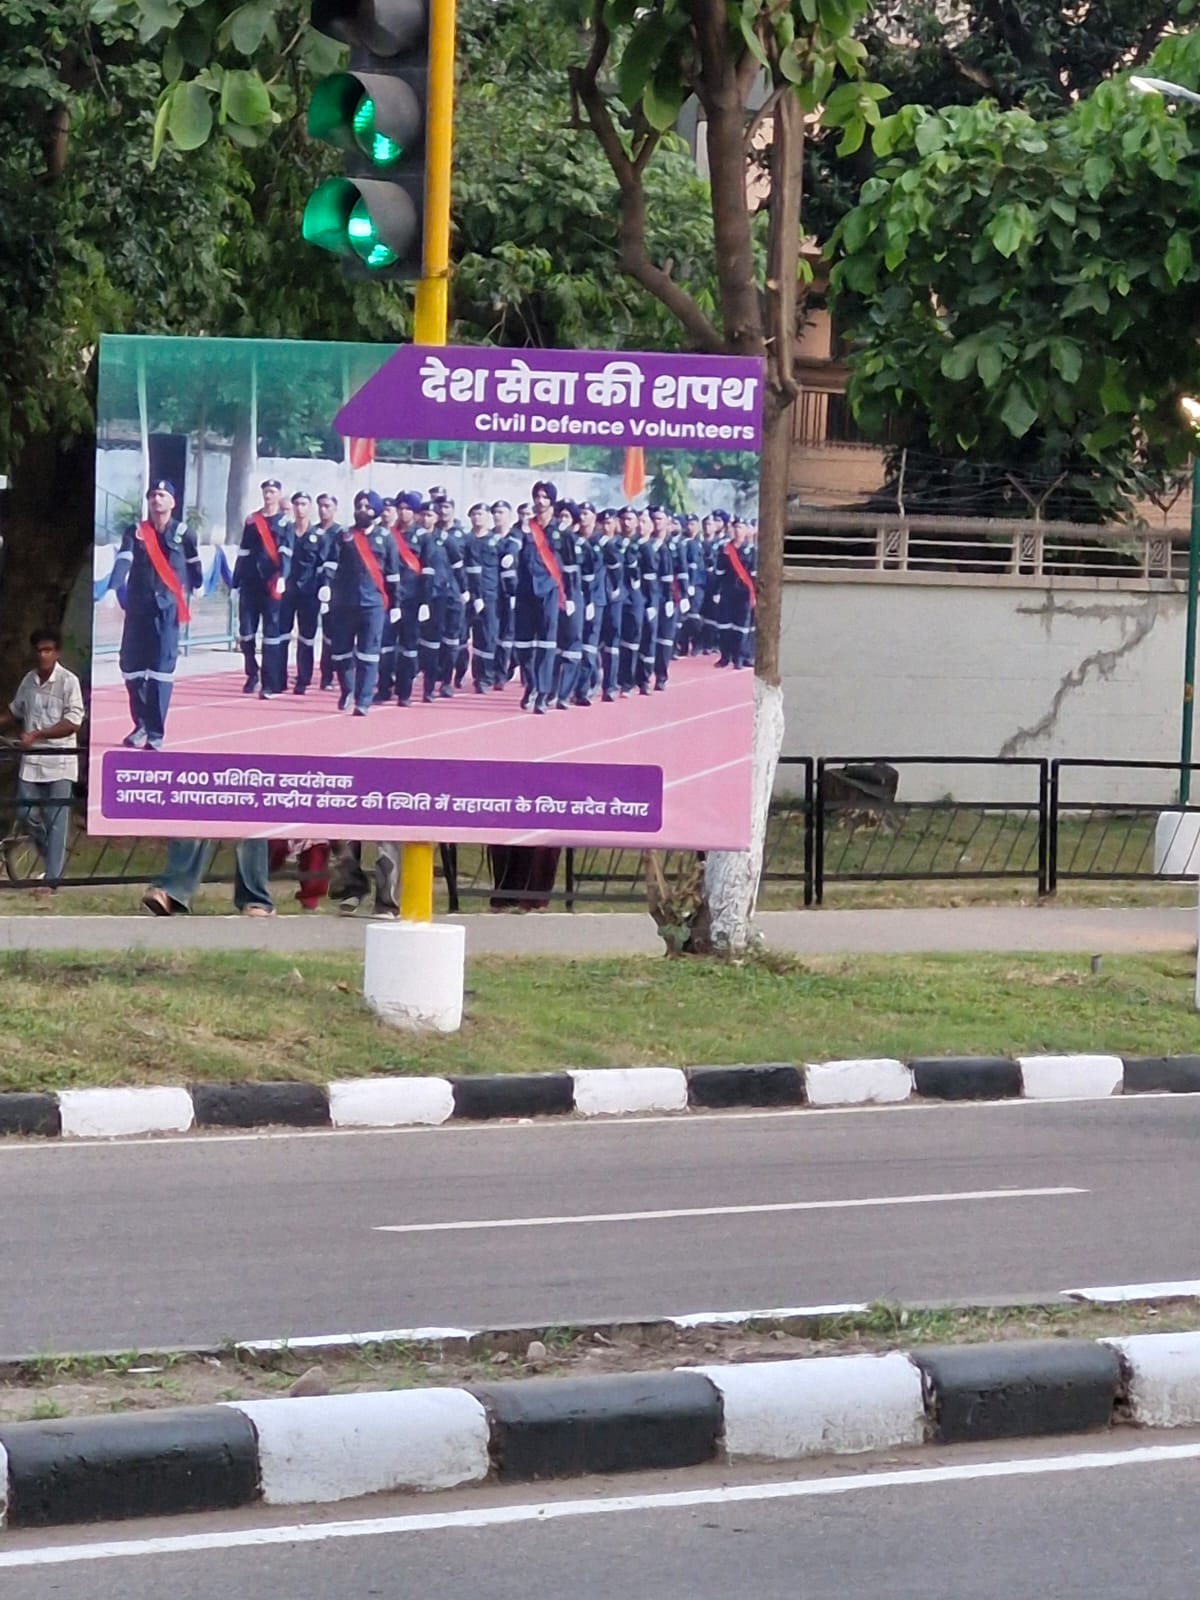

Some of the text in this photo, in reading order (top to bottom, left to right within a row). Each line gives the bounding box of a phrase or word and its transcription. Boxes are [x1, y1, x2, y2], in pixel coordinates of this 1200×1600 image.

[420, 357, 758, 411] देश सेवा की शपथ
[475, 413, 754, 439] Civil Defence Volunteers
[116, 769, 353, 789] लगभग 400 प्रशिक्षित स्वयंसेवक
[116, 790, 165, 805] आपदा,
[171, 791, 258, 807] आपातकाल,
[262, 791, 313, 808] राष्ट्रीय
[360, 792, 383, 808] की
[386, 792, 432, 810] स्थिति
[434, 794, 450, 811] में
[452, 798, 512, 813] सहायता
[515, 796, 533, 812] के
[535, 796, 567, 813] लिए
